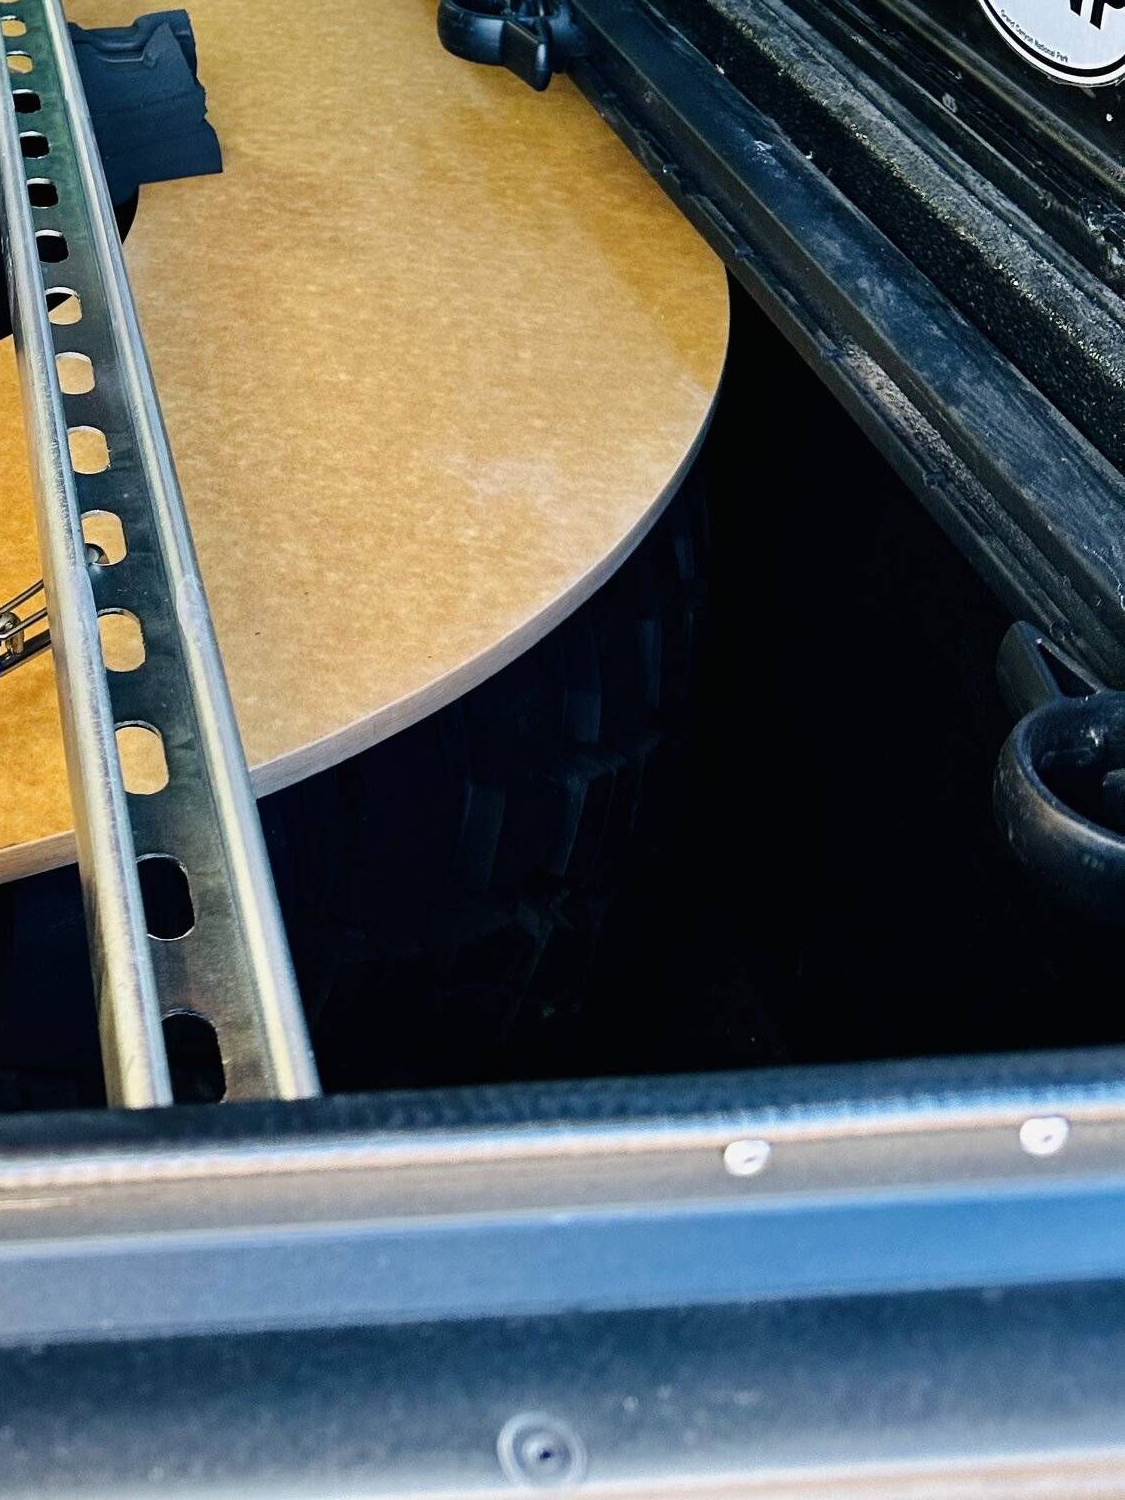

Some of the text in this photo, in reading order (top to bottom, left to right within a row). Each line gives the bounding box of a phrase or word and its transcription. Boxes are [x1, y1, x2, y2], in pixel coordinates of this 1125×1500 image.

[1000, 8, 1069, 63] Grand Canyon National Park
